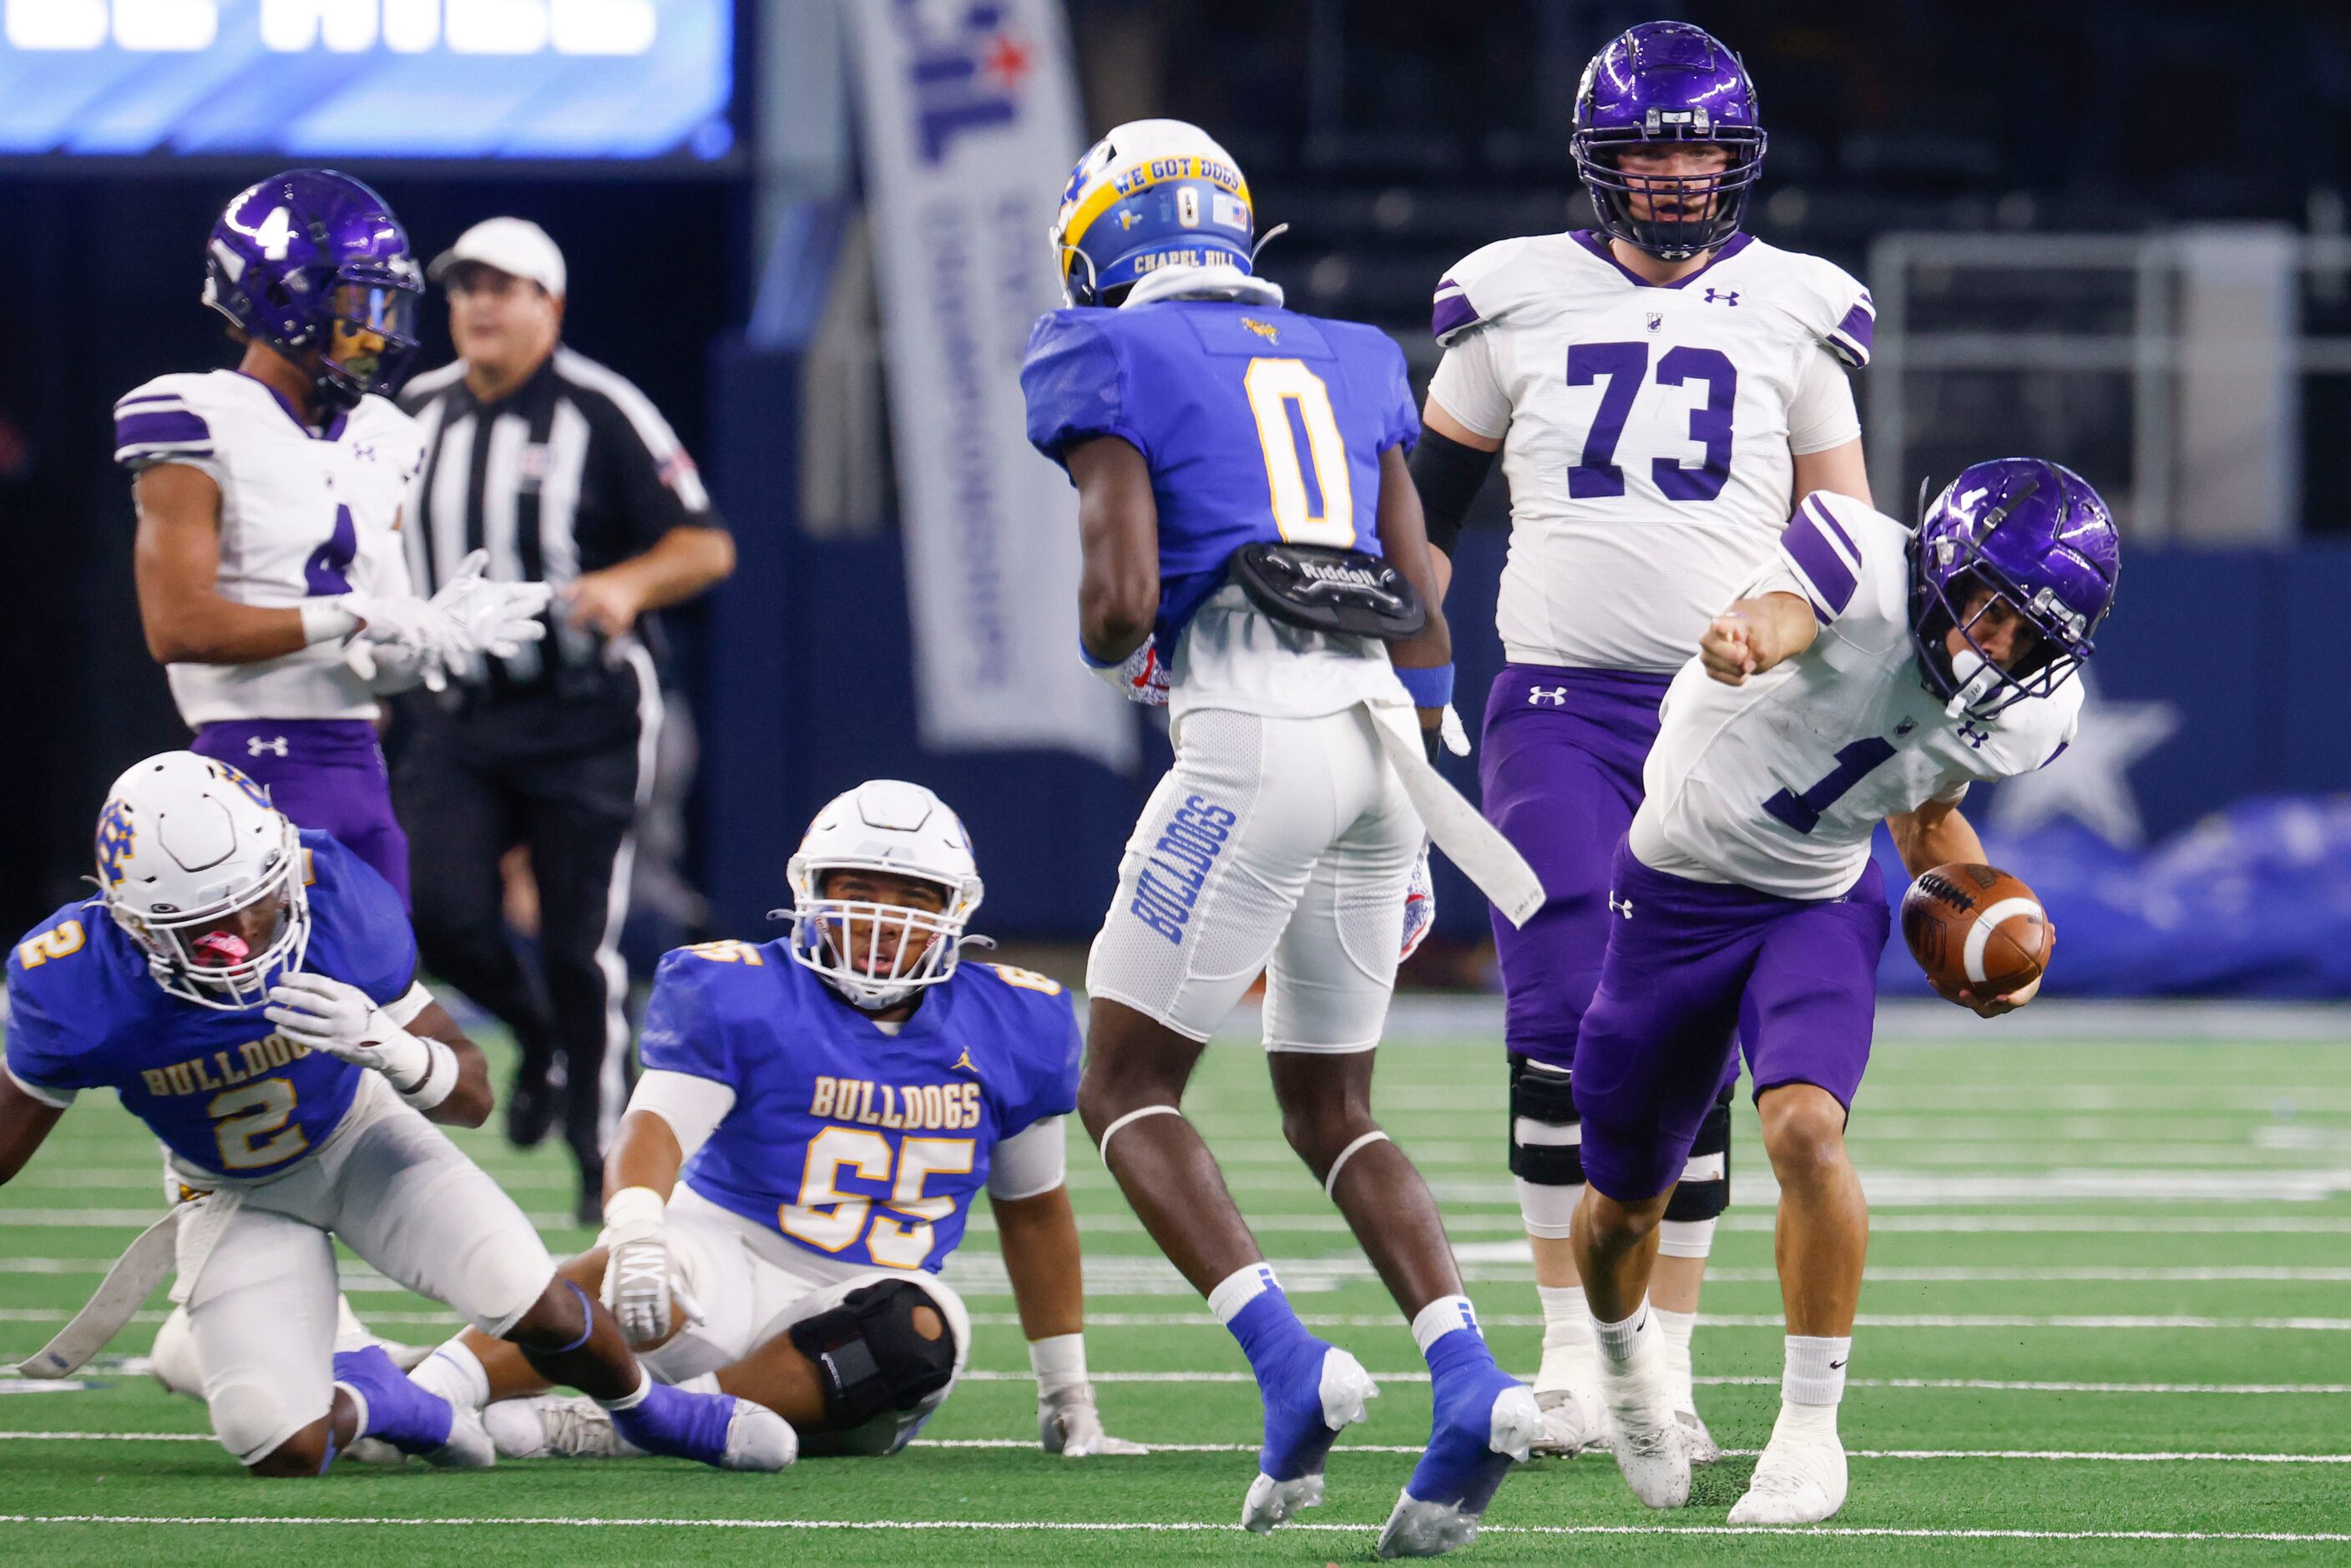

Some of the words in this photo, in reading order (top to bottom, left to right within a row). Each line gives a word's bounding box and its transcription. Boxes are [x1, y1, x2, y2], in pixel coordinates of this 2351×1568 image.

[1112, 167, 1145, 196] WE
[1150, 157, 1192, 180] GOT
[1200, 158, 1240, 191] DOGS
[1176, 185, 1200, 229] 0
[1133, 250, 1201, 275] CHAPEL
[1205, 250, 1237, 268] HILL
[1242, 357, 1357, 549] 0
[1566, 341, 1738, 501] 73
[1298, 560, 1378, 586] Riddell
[1761, 735, 1898, 835] 1
[1130, 795, 1237, 946] BULLDOGS
[18, 918, 87, 971] 2
[140, 1031, 313, 1096] BULLDO
[206, 1076, 310, 1170] 2
[808, 1075, 982, 1131] BULLDOGS
[776, 1125, 976, 1270] 65
